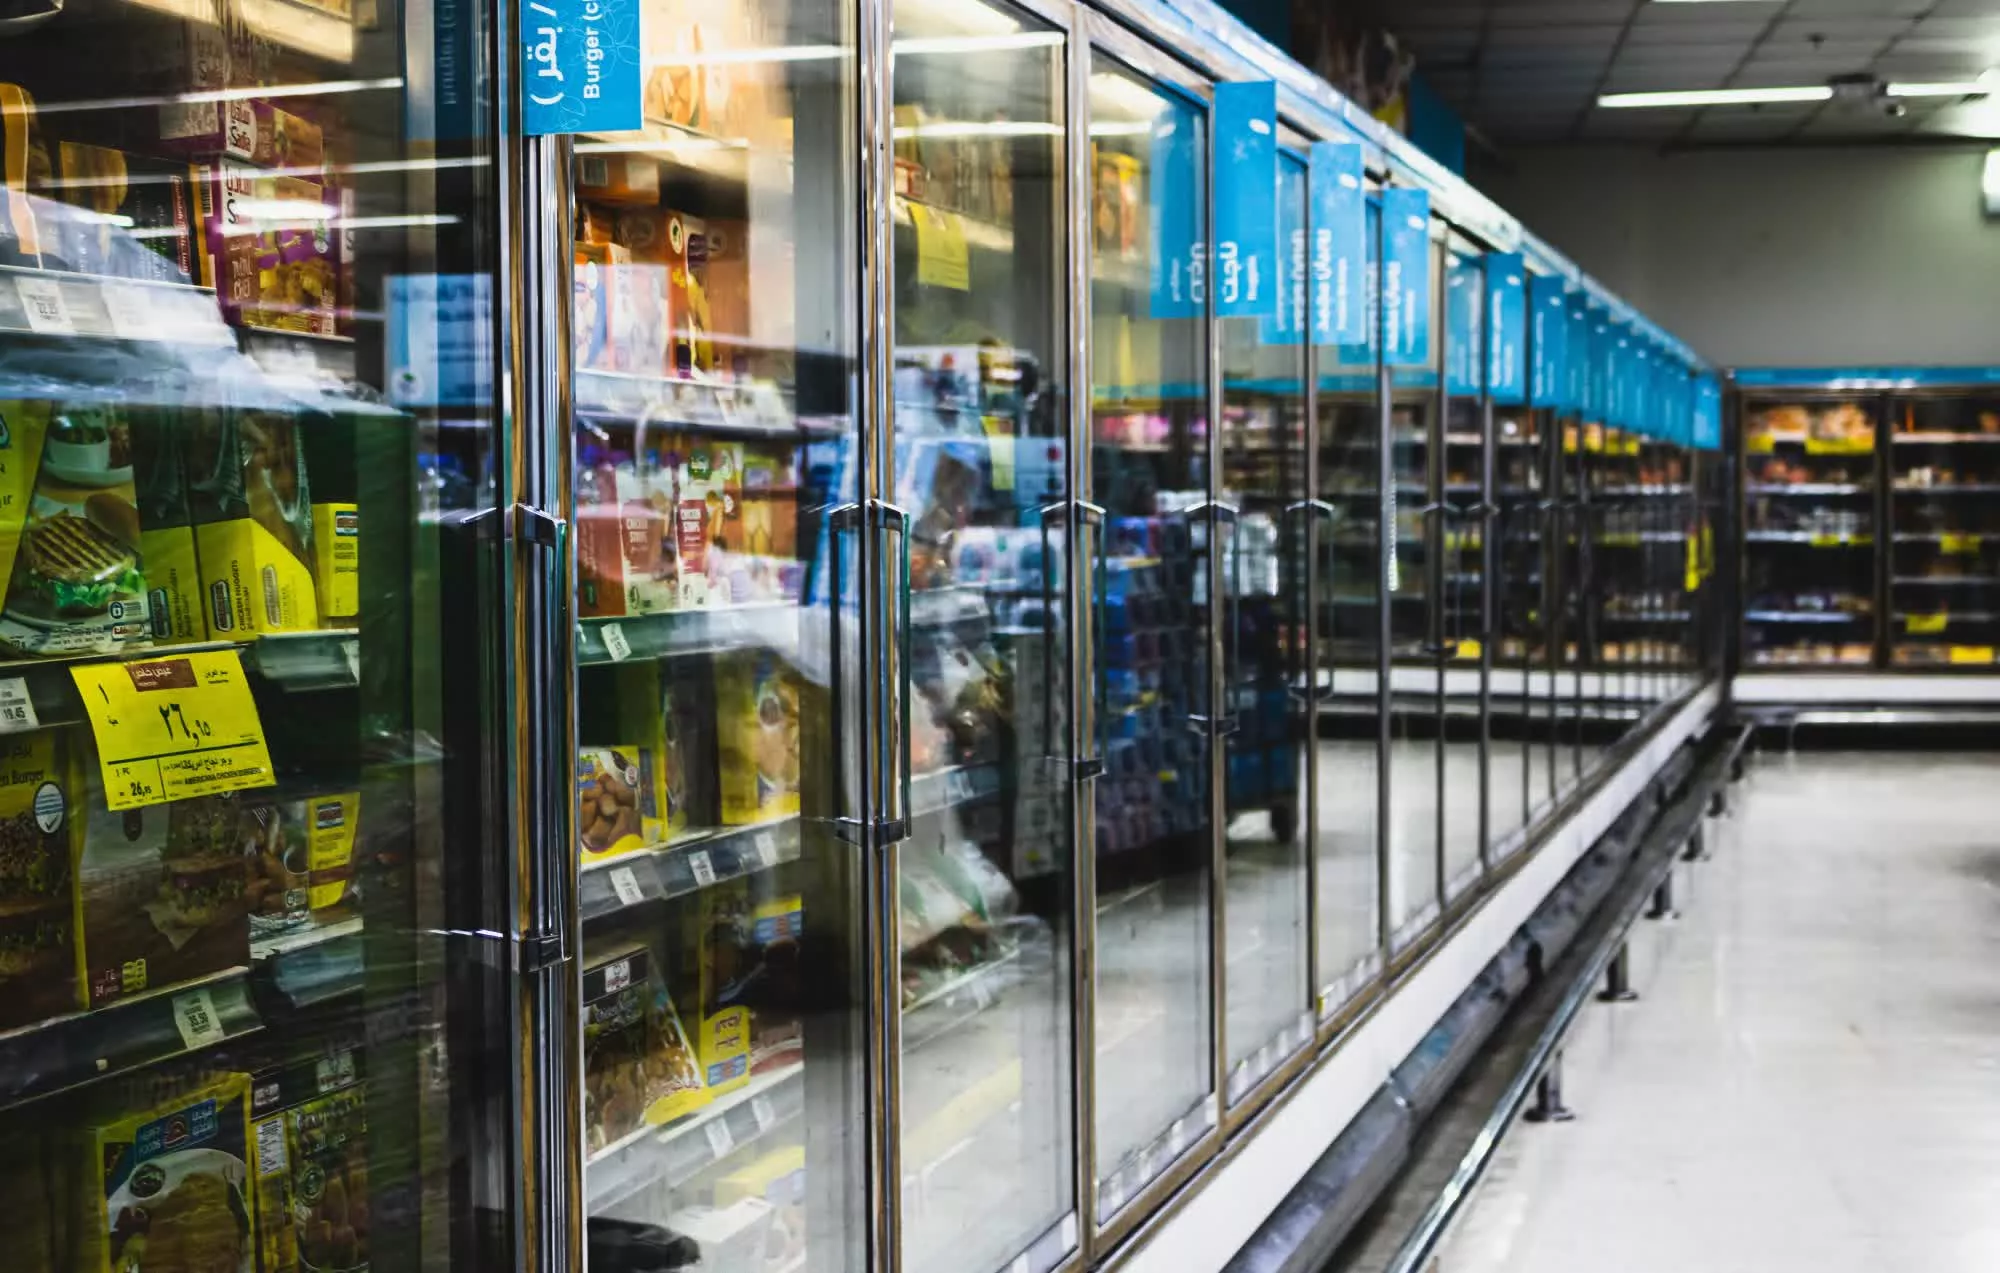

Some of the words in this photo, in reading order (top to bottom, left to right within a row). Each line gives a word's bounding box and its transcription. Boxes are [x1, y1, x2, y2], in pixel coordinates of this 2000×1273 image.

[526, 26, 565, 82] بقر
[583, 26, 604, 99] Burger
[231, 559, 243, 597] NUGGETS
[236, 597, 247, 632] CHICKEN
